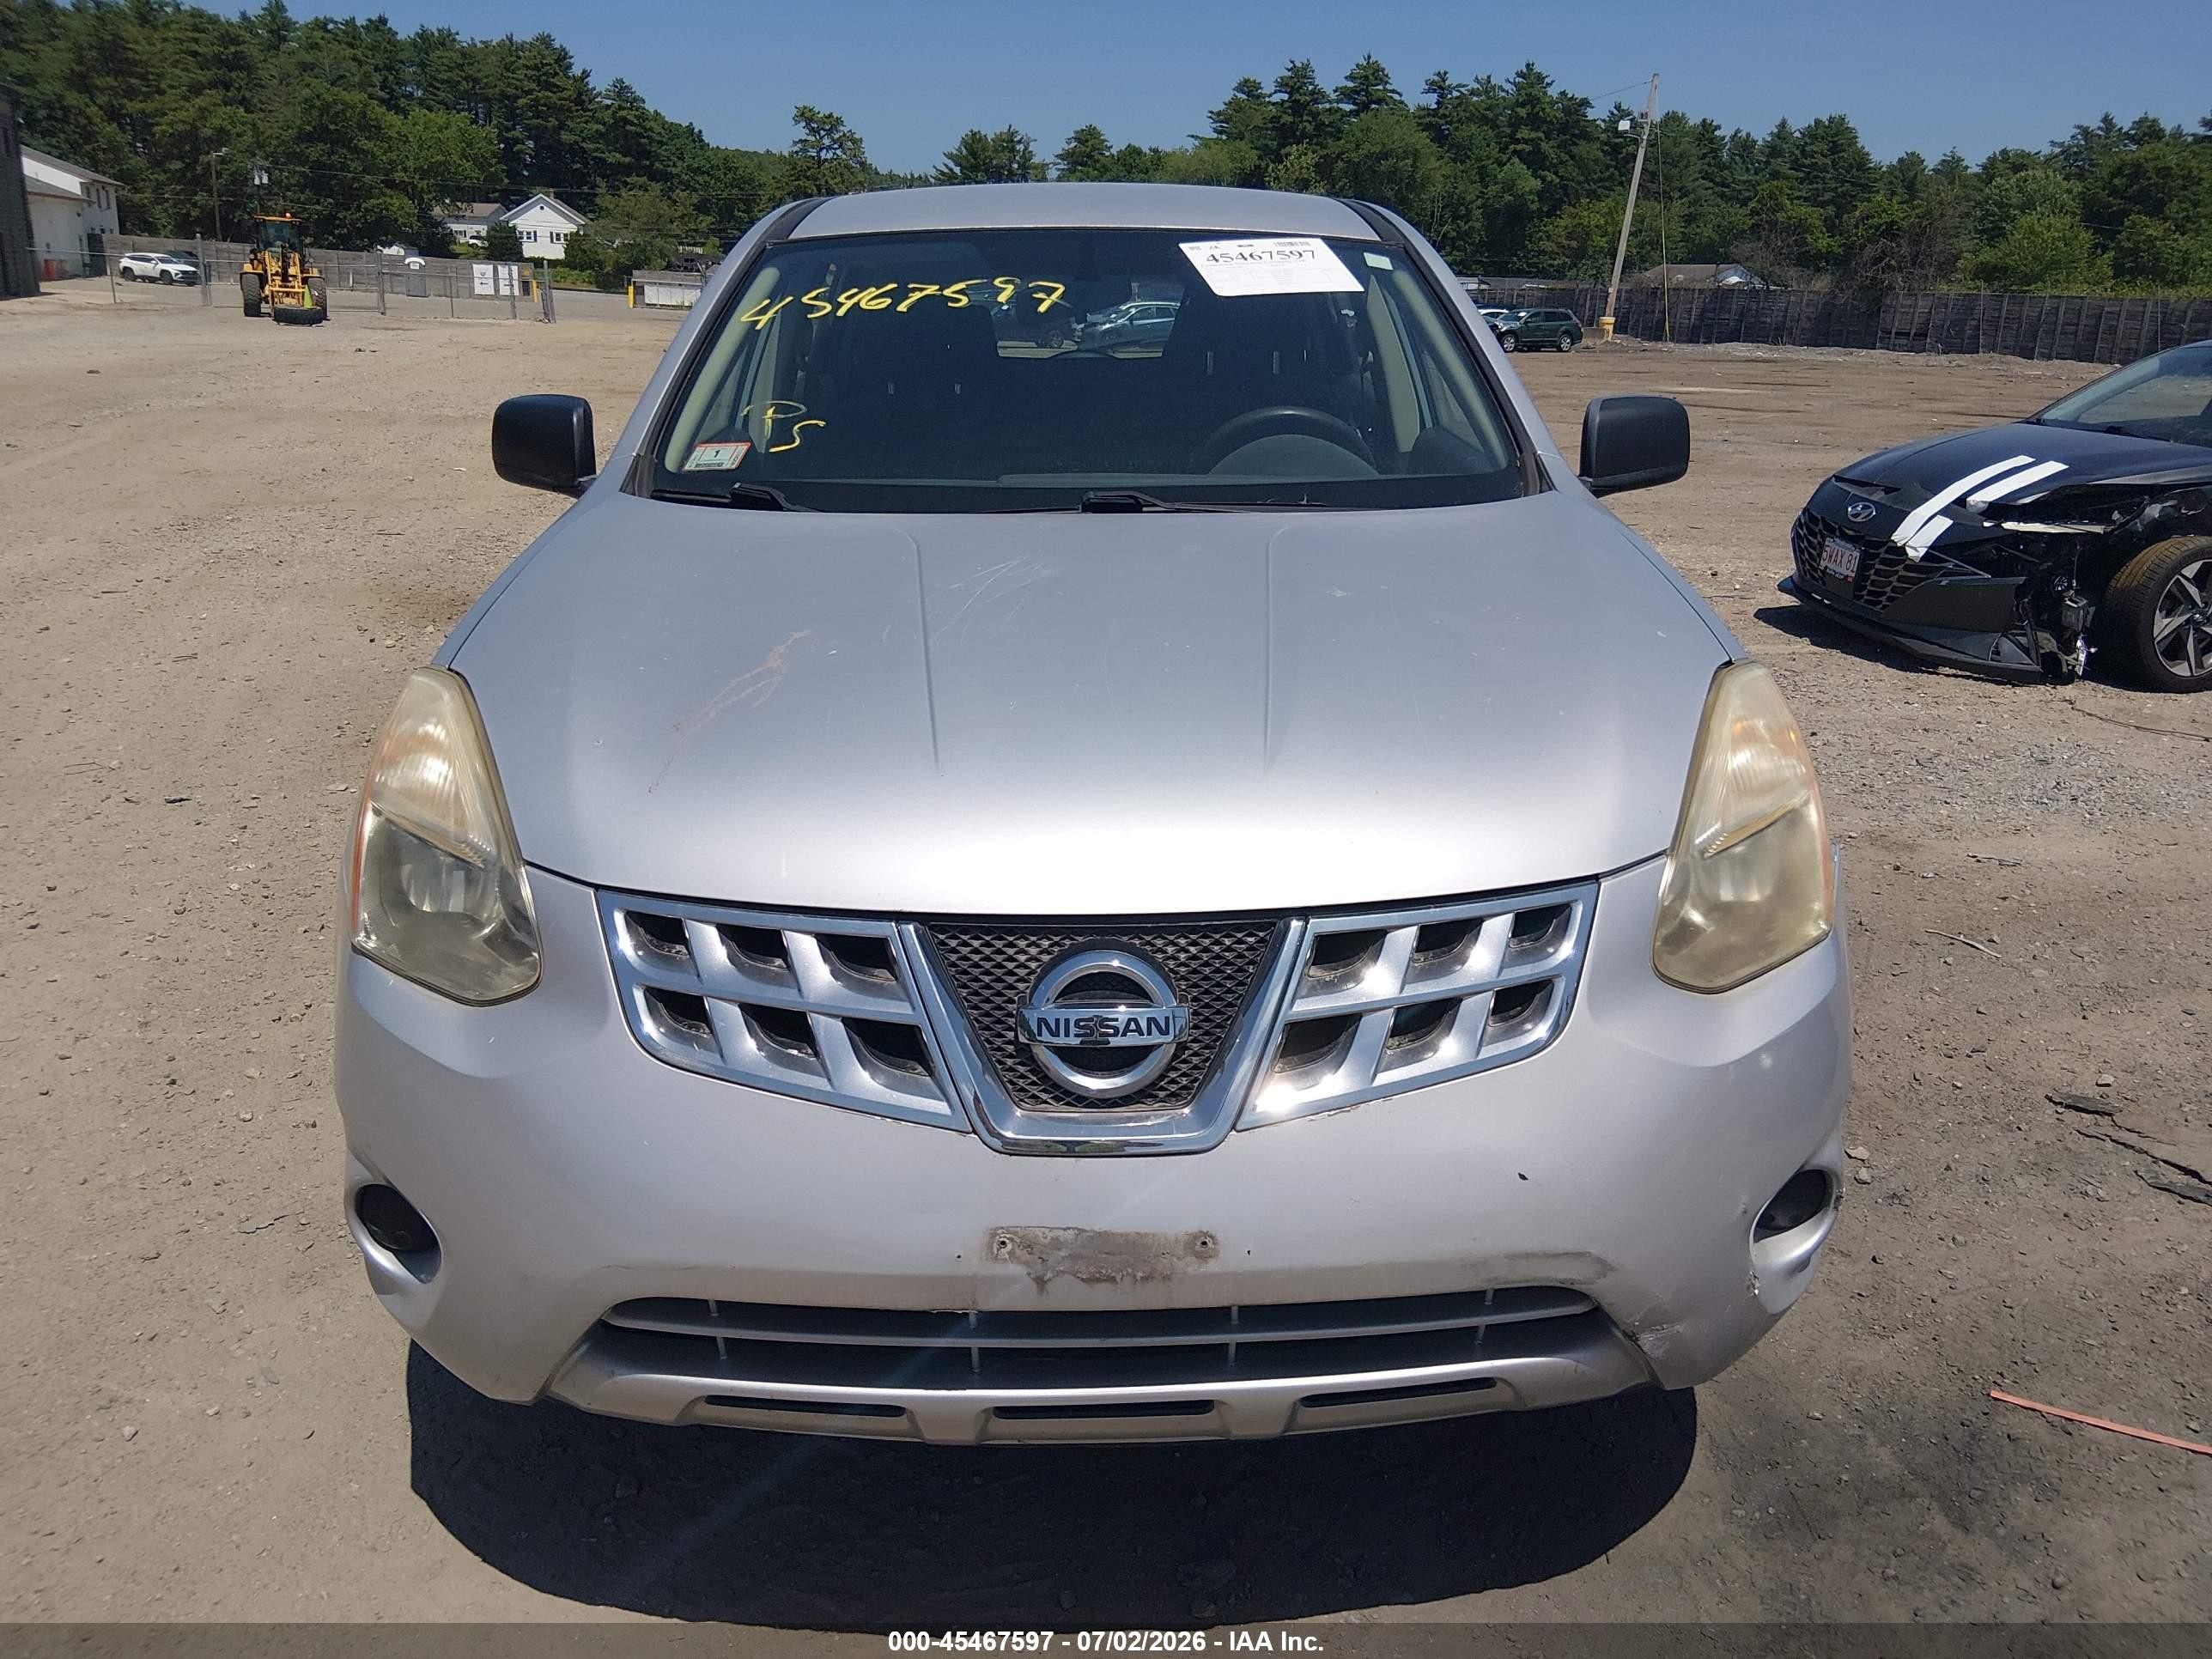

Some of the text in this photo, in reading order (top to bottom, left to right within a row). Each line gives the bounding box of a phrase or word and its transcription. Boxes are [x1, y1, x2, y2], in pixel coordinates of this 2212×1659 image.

[1206, 249, 1316, 264] 45467597
[740, 276, 1073, 331] 45467597
[1845, 553, 1857, 574] 81
[1036, 1015, 1170, 1038] NISSAN
